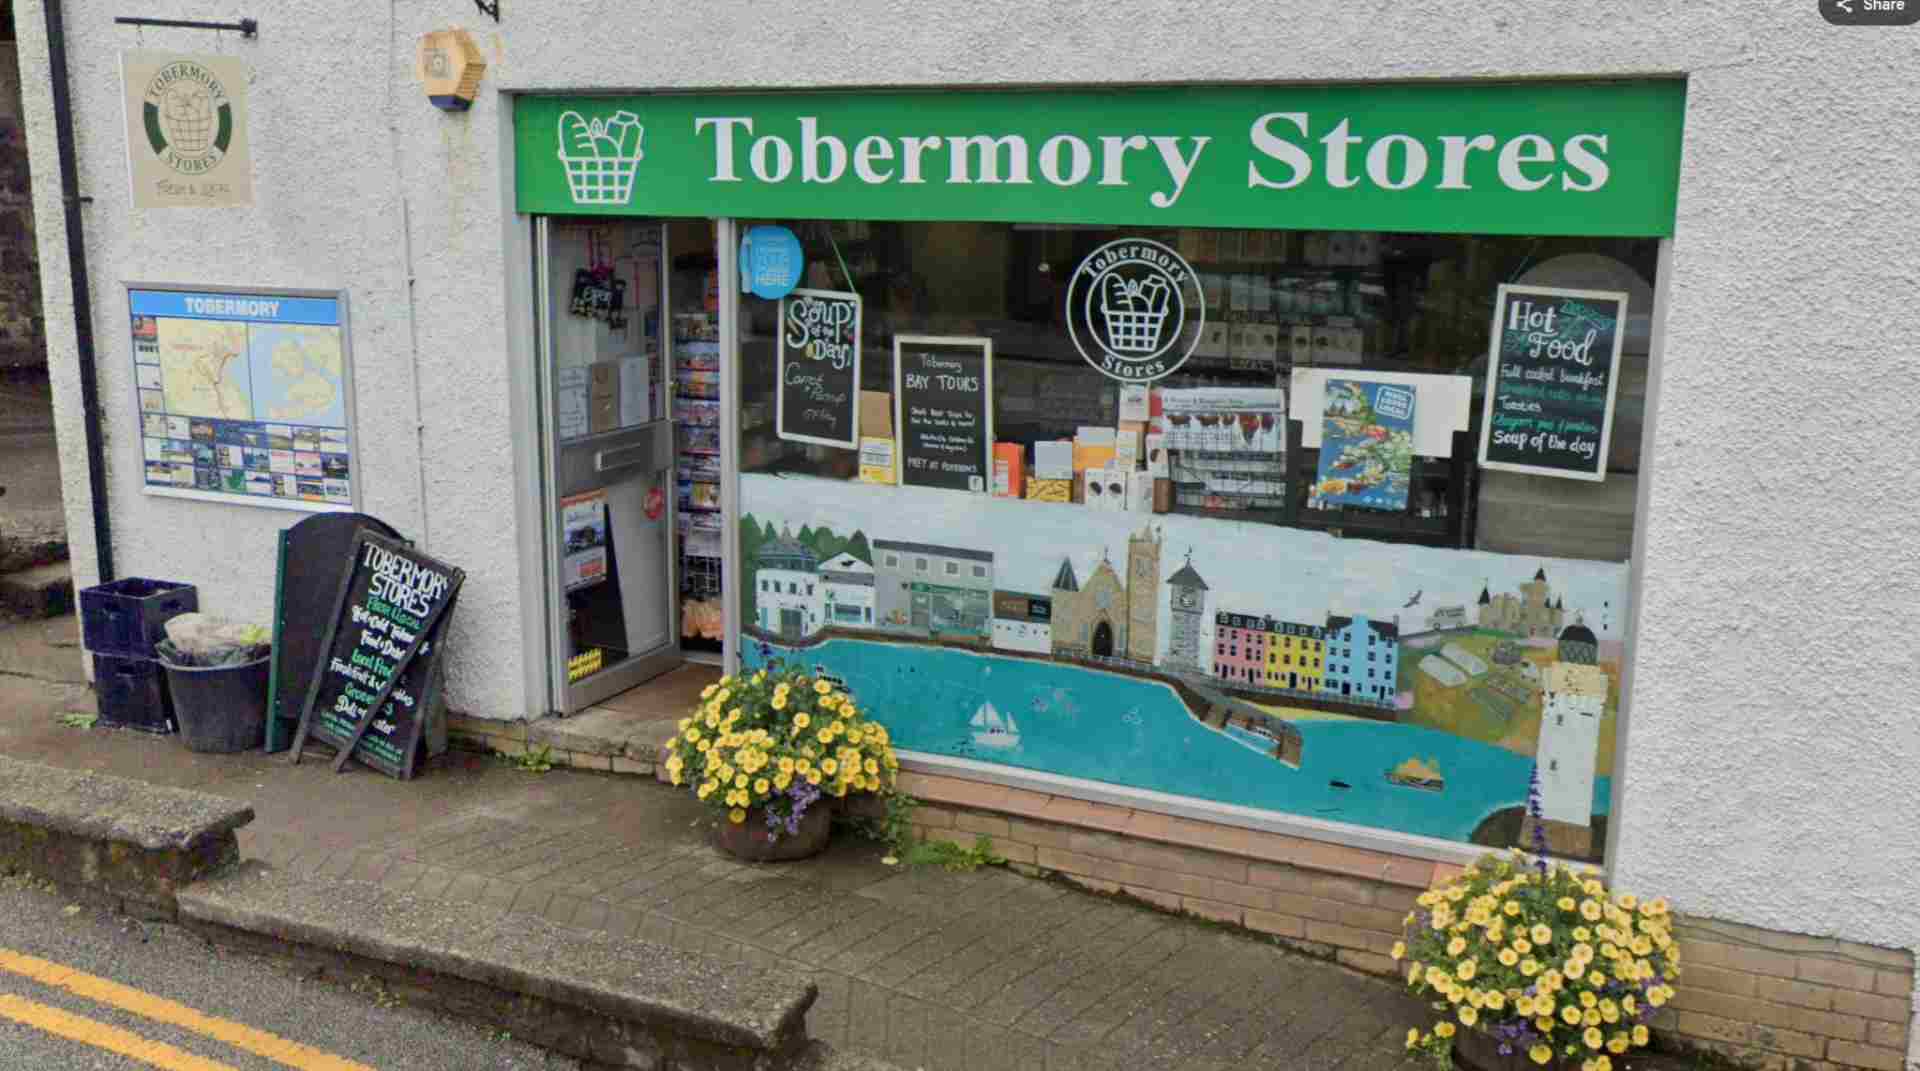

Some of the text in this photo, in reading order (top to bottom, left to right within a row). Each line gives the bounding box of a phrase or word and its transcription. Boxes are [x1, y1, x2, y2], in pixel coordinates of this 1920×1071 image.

[149, 63, 227, 98] TOBERMORY
[695, 111, 1610, 209] Tobermory Stores
[1081, 246, 1190, 283] Tobermory
[184, 297, 281, 317] TOBERMORY
[1508, 300, 1557, 333] Hot
[1528, 328, 1597, 366] Food
[1102, 354, 1165, 377] Stores
[906, 373, 979, 393] BAY TOURS
[1531, 432, 1548, 453] of
[1550, 433, 1567, 450] the
[1570, 436, 1596, 459] day
[367, 572, 431, 618] STORES
